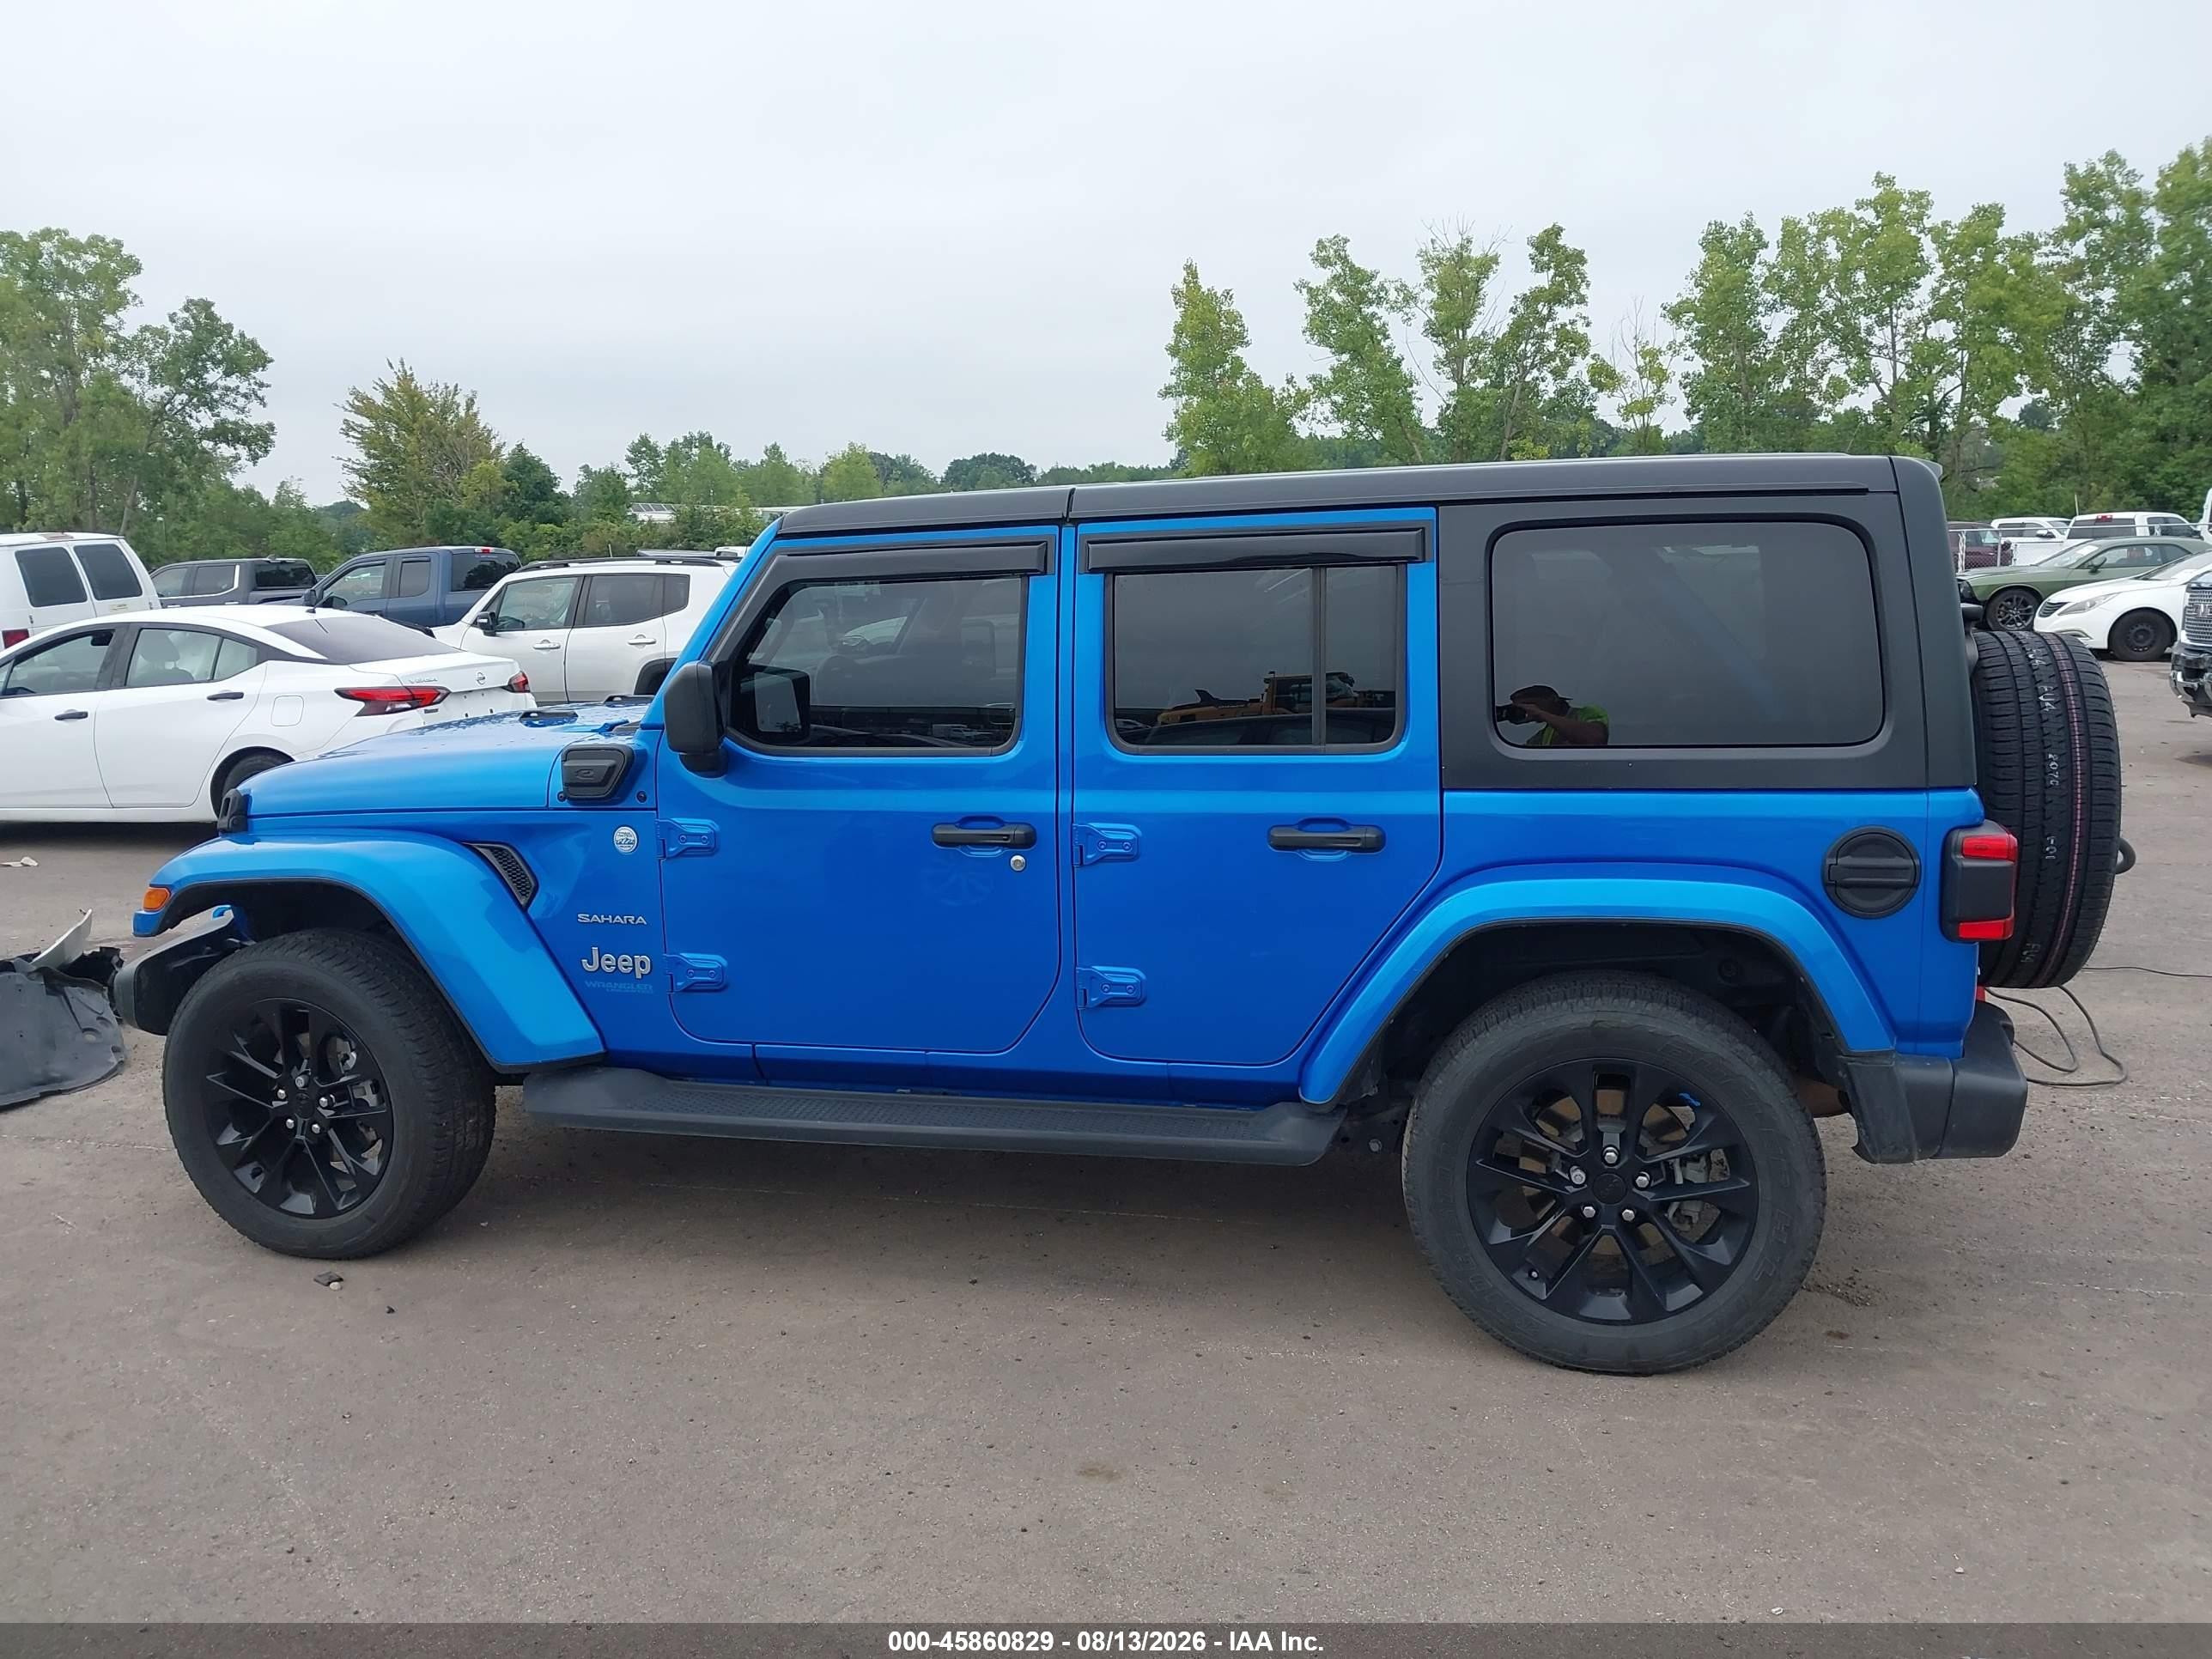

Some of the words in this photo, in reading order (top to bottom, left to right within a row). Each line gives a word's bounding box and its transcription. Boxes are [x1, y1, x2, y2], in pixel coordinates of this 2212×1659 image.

[577, 913, 647, 925] SAHARA
[581, 947, 651, 979] Jeep
[584, 980, 653, 991] WRANGLER
